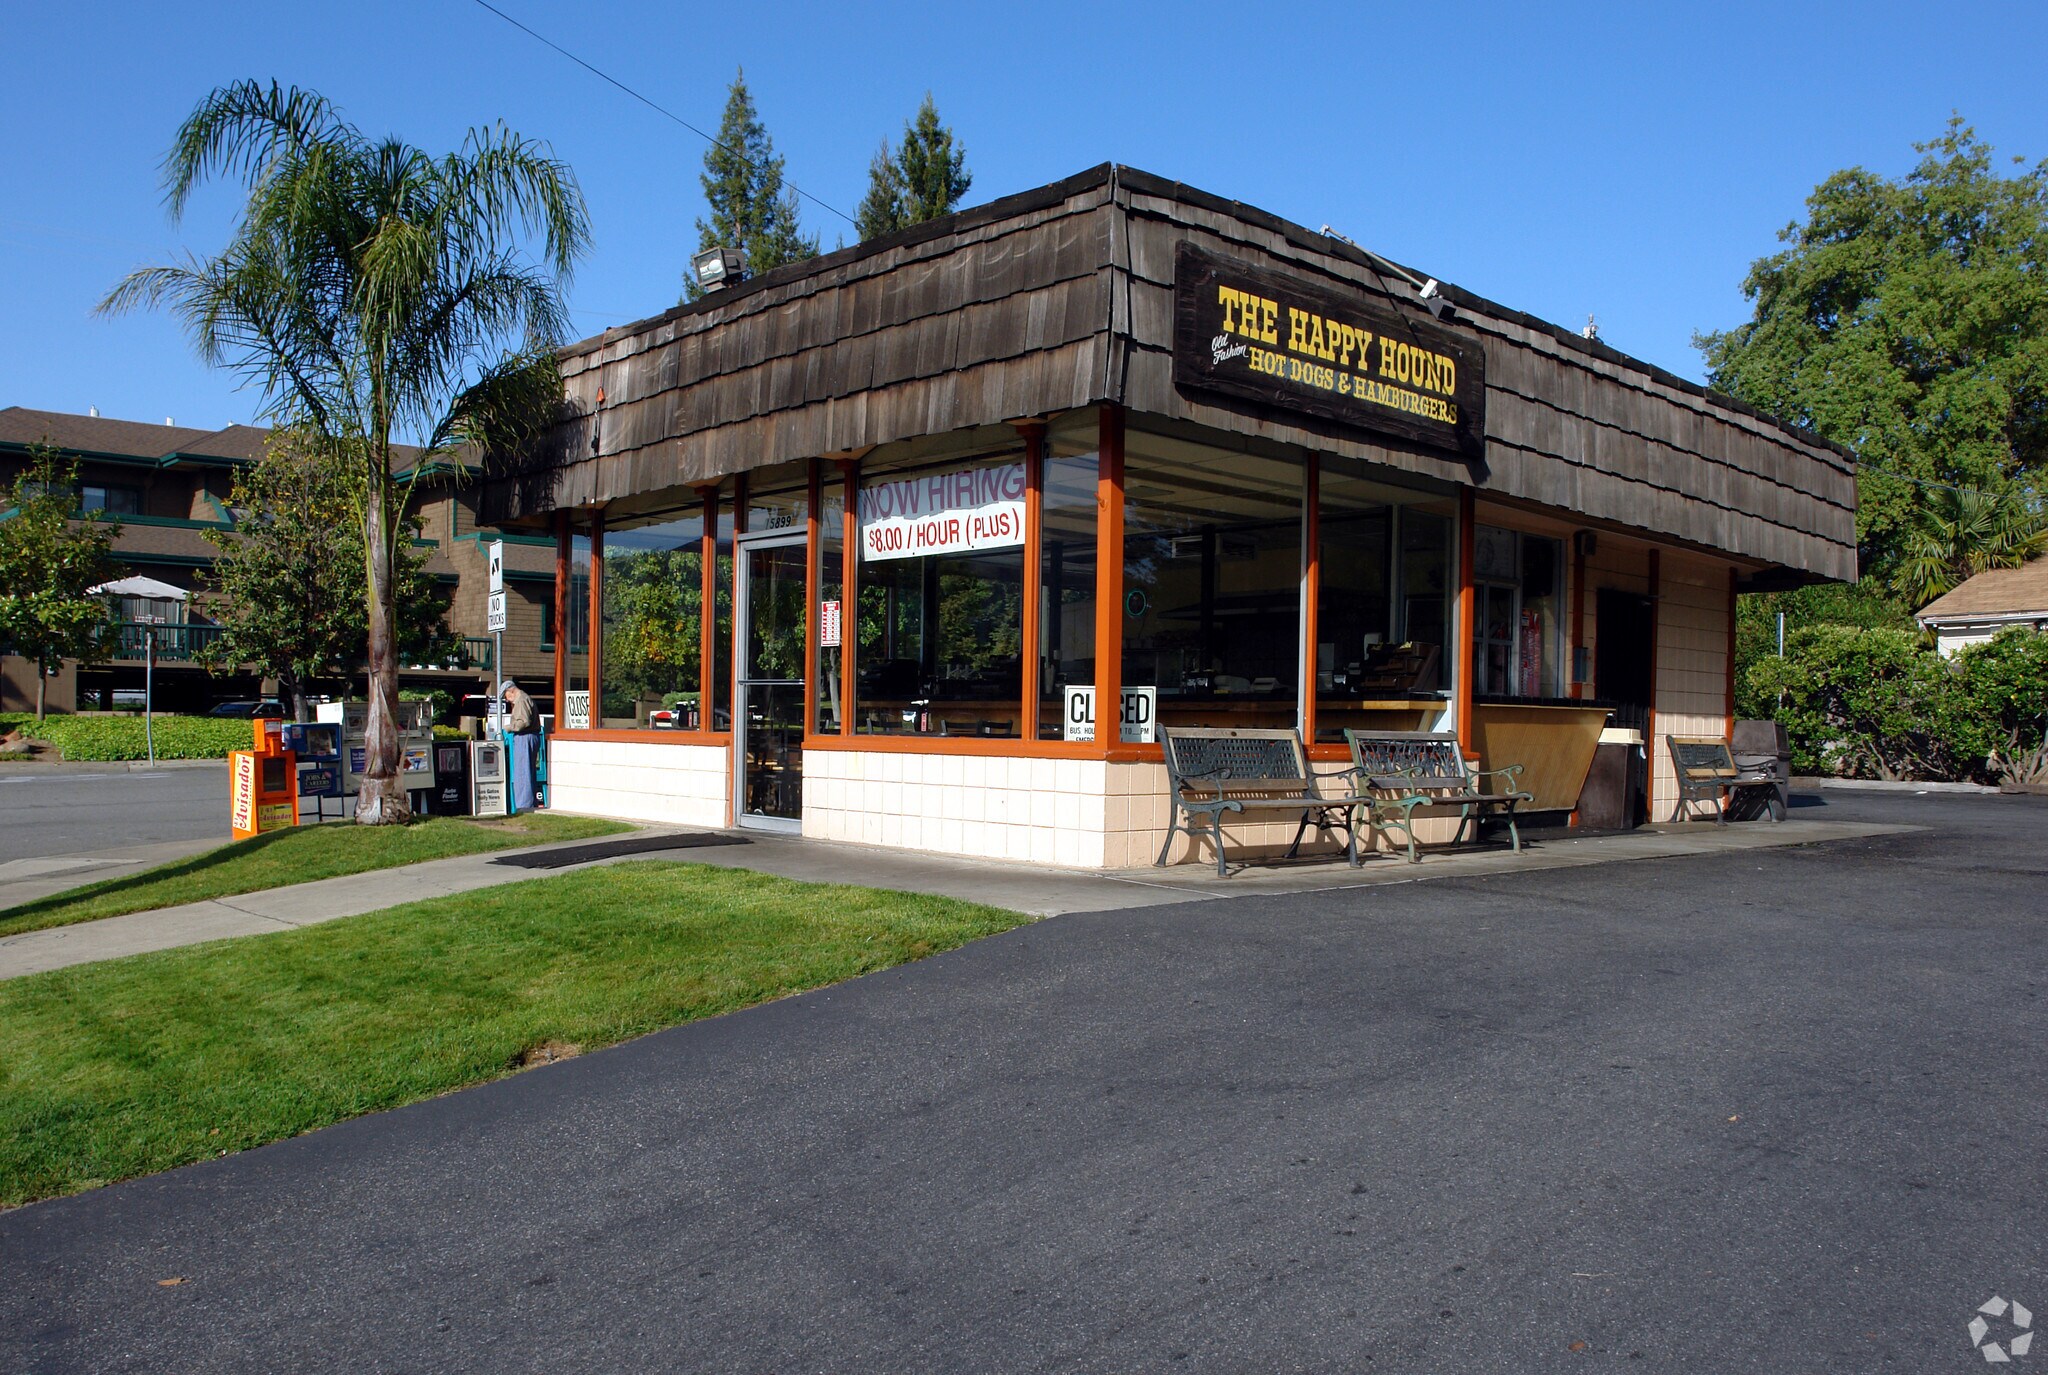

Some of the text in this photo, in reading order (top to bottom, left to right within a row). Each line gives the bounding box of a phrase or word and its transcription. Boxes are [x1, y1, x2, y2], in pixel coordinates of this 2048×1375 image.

[1211, 333, 1229, 351] Old
[1213, 342, 1249, 365] Fashion
[1218, 285, 1456, 396] THE HAPPY HOUND
[1248, 346, 1457, 424] HOT DOGS & HAMBURGERS
[862, 463, 1026, 519] NOW HIRING
[766, 515, 791, 530] 15899
[869, 527, 902, 553] $8.00
[917, 519, 959, 547] HOUR
[491, 597, 500, 611] NO
[489, 613, 505, 626] TRUCKS
[1071, 693, 1150, 724] CLED
[1125, 727, 1132, 735] TO
[236, 756, 250, 829] Avisador
